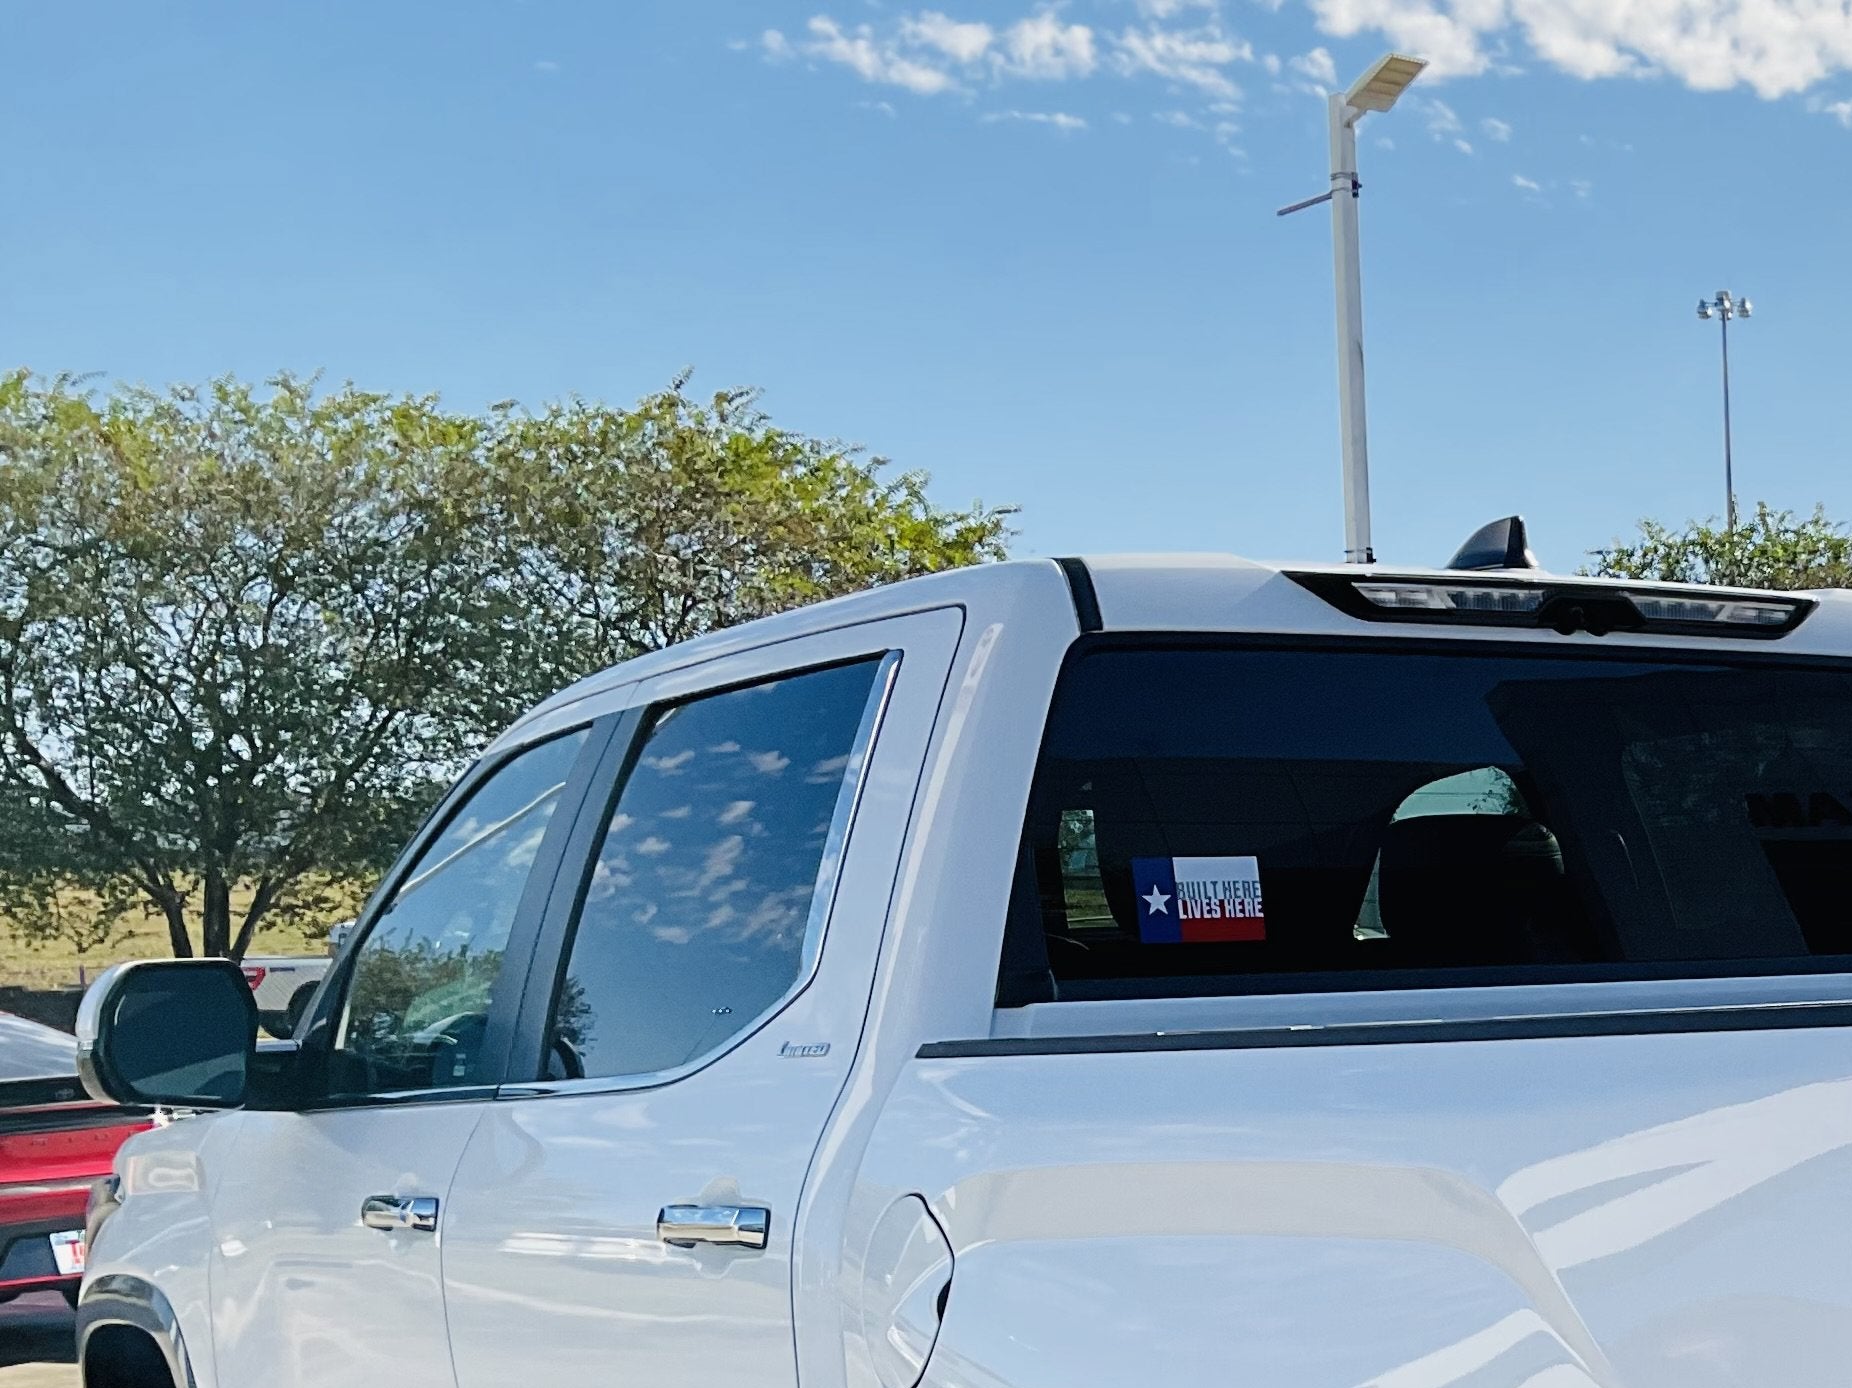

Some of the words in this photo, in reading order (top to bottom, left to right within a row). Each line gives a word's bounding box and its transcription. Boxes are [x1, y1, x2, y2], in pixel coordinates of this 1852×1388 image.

[1176, 881, 1218, 900] BUILT
[1222, 880, 1261, 899] HERE
[1178, 899, 1221, 919] LIVES
[1224, 898, 1264, 918] HERE
